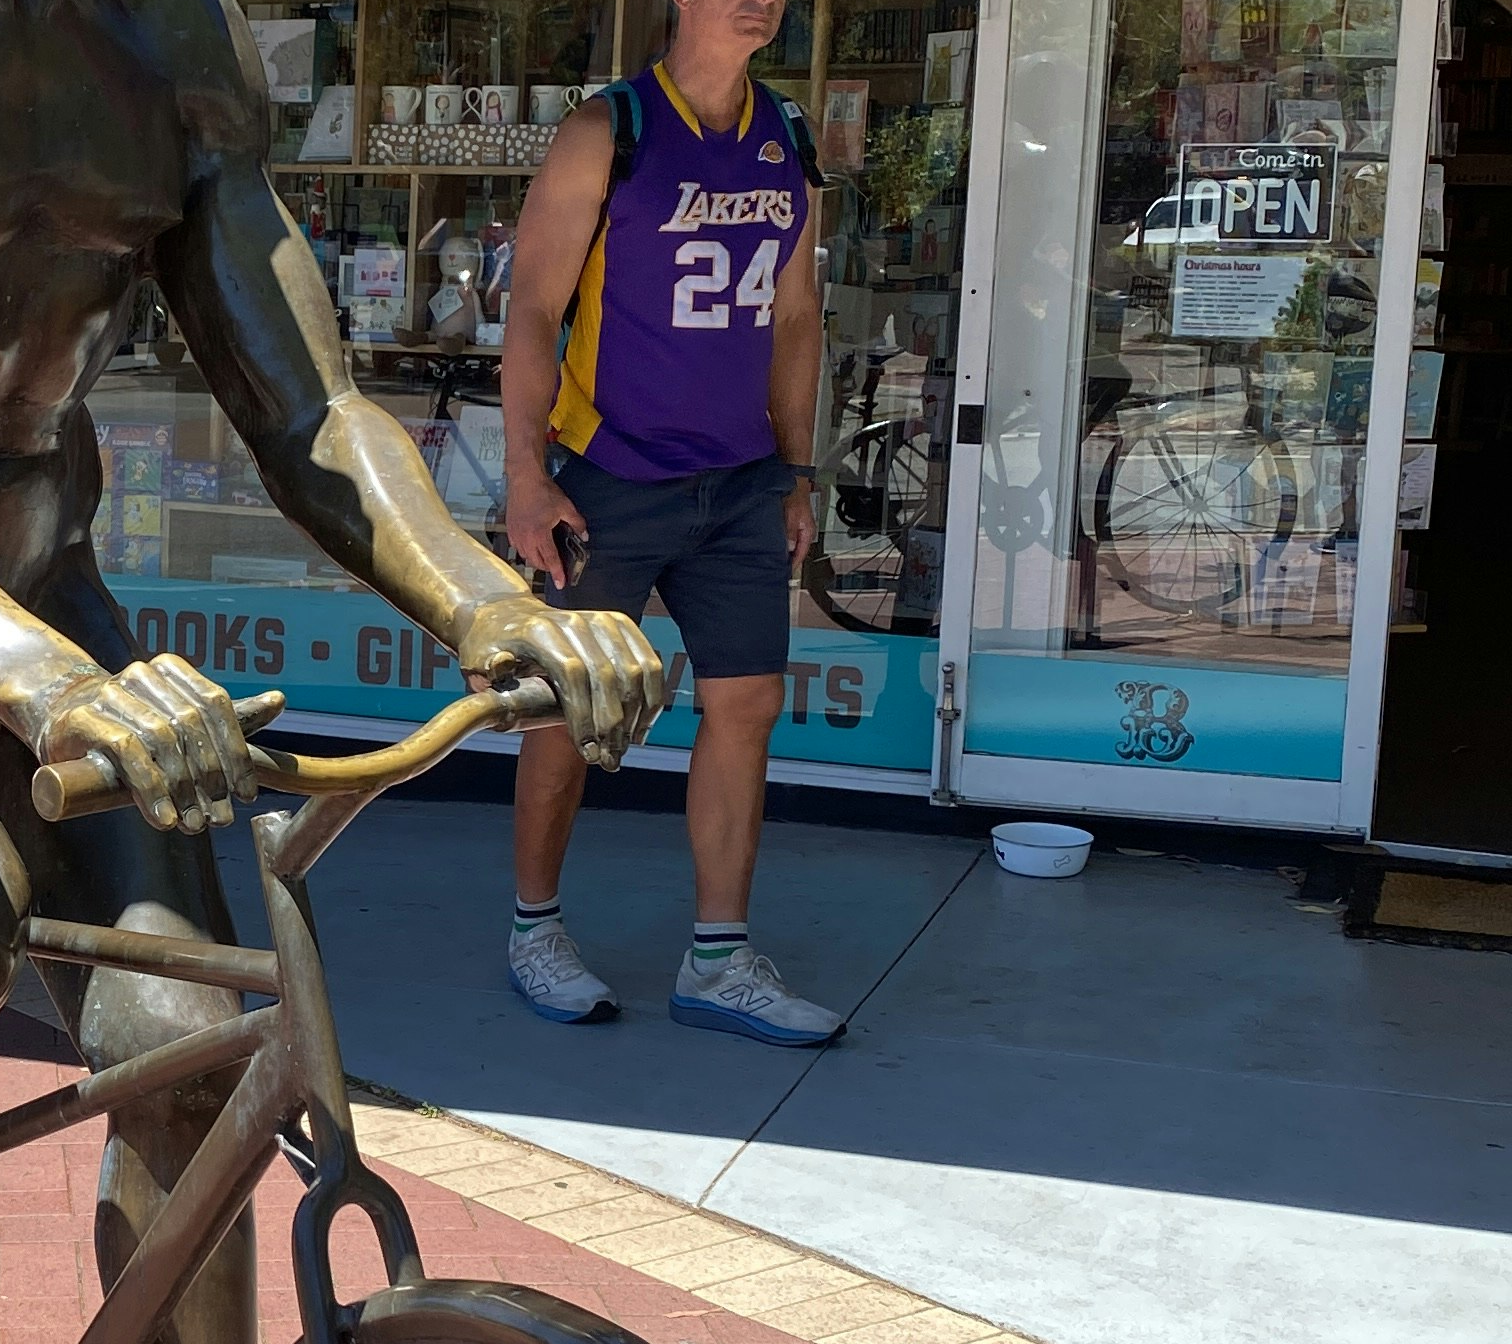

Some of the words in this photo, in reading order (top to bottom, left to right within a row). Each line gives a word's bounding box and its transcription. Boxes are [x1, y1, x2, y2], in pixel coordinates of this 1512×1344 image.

[1234, 148, 1297, 169] Come
[1302, 148, 1326, 169] in
[657, 181, 796, 232] LAKERS
[1190, 177, 1321, 235] OPEN
[671, 238, 781, 328] 24
[1183, 259, 1232, 271] Christmas
[1233, 260, 1262, 271] hours
[117, 604, 284, 675] OOKS
[356, 624, 450, 690] GIF
